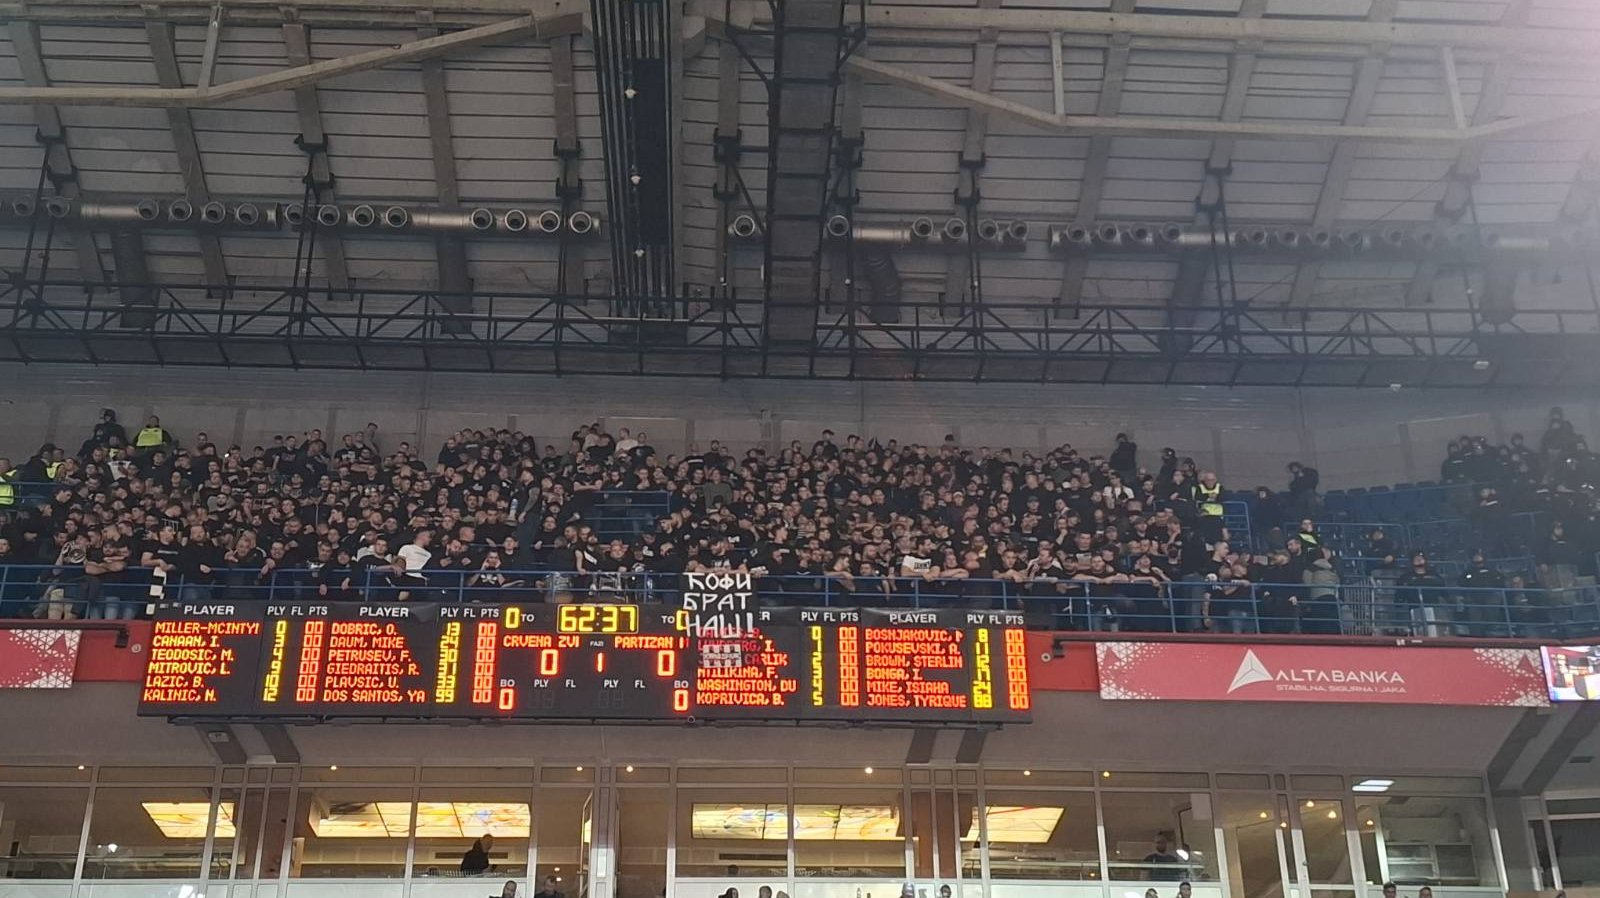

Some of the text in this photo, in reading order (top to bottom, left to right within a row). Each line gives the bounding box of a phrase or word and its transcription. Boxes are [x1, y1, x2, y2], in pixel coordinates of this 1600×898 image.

[683, 593, 752, 611] БРАТ
[184, 605, 234, 615] PLAYER
[267, 606, 327, 615] PLY FL PTS
[360, 607, 409, 617] PLAYER
[441, 608, 499, 618] PLY FL PTS
[521, 614, 534, 622] TO
[560, 607, 635, 632] 62:37
[662, 615, 675, 624] TO
[801, 612, 858, 622] PLY FL PTS
[890, 613, 936, 623] PLAYER
[967, 615, 1023, 624] PLY FL PTS
[276, 621, 286, 634] 0
[305, 622, 324, 634] 00
[332, 623, 397, 635] DOBRIC, O.
[447, 622, 460, 636] 13
[478, 623, 496, 636] 00
[685, 612, 754, 638] НАШ!
[812, 626, 821, 640] 0
[839, 627, 857, 639] 00
[979, 629, 988, 642] 8
[1005, 629, 1024, 642] 00
[153, 636, 206, 647] CANAAN,
[275, 635, 285, 647] 3
[303, 635, 322, 647] 00
[330, 637, 404, 648] DAUM, MIKE
[440, 635, 459, 648] 24
[477, 637, 495, 649] 00
[503, 636, 551, 647] CRVENA
[615, 637, 672, 648] PARTIZAN
[840, 640, 857, 652] 00
[273, 648, 283, 660] 4
[301, 648, 320, 660] 00
[866, 642, 945, 654] POKUSEVSKI,
[976, 642, 988, 654] 11
[1007, 643, 1025, 655] 00
[152, 649, 234, 661] TEODOSIC, M.
[328, 650, 411, 661] PETRUSEV, F.
[440, 649, 458, 662] 30
[476, 650, 495, 662] 00
[813, 652, 822, 665] 2
[840, 653, 857, 665] 00
[271, 661, 281, 673] 9
[541, 649, 558, 675] 0
[658, 650, 675, 676] 0
[866, 656, 962, 668] BROWN, STERLIN
[977, 655, 989, 668] 12
[1008, 656, 1025, 668] 00
[148, 663, 230, 675] MITROVIC, L.
[299, 662, 318, 674] 00
[327, 664, 420, 675] GIEDRAITIS, R.
[438, 662, 457, 675] 31
[475, 663, 493, 675] 00
[767, 667, 778, 678] F.
[813, 665, 822, 678] 3
[840, 666, 858, 678] 00
[866, 668, 909, 680] BONGA,
[265, 675, 280, 687] 10
[1008, 669, 1026, 681] 00
[1276, 669, 1404, 683] ALTABANKA
[146, 677, 204, 688] LAZIC, B.
[298, 676, 317, 687] 00
[325, 677, 383, 688] PLAVSIC,
[438, 675, 456, 689] 33
[474, 676, 492, 689] 00
[500, 679, 515, 687] BO
[534, 680, 548, 688] PLY
[566, 680, 576, 688] FL
[604, 680, 618, 688] PLY
[635, 680, 645, 688] FL
[697, 679, 796, 690] WASHINGTON, DU
[813, 679, 822, 691] 4
[841, 680, 858, 691] 00
[867, 681, 949, 693] MIKE, ISIAHA
[973, 681, 991, 694] 24
[1009, 682, 1027, 694] 00
[143, 690, 217, 701] KALINIC, N.
[263, 688, 278, 701] 12
[296, 689, 315, 701] 00
[323, 690, 425, 702] DOS SANTOS, YA
[436, 689, 454, 702] 99
[473, 690, 491, 703] 00
[499, 689, 513, 710] 0
[674, 690, 688, 711] 0
[697, 693, 784, 705] KOPRIVICA, B.
[813, 692, 822, 705] 5
[841, 693, 859, 705] 00
[867, 695, 966, 707] JONES, TYRIQUE
[974, 695, 992, 708] 88
[1010, 695, 1029, 708] 00
